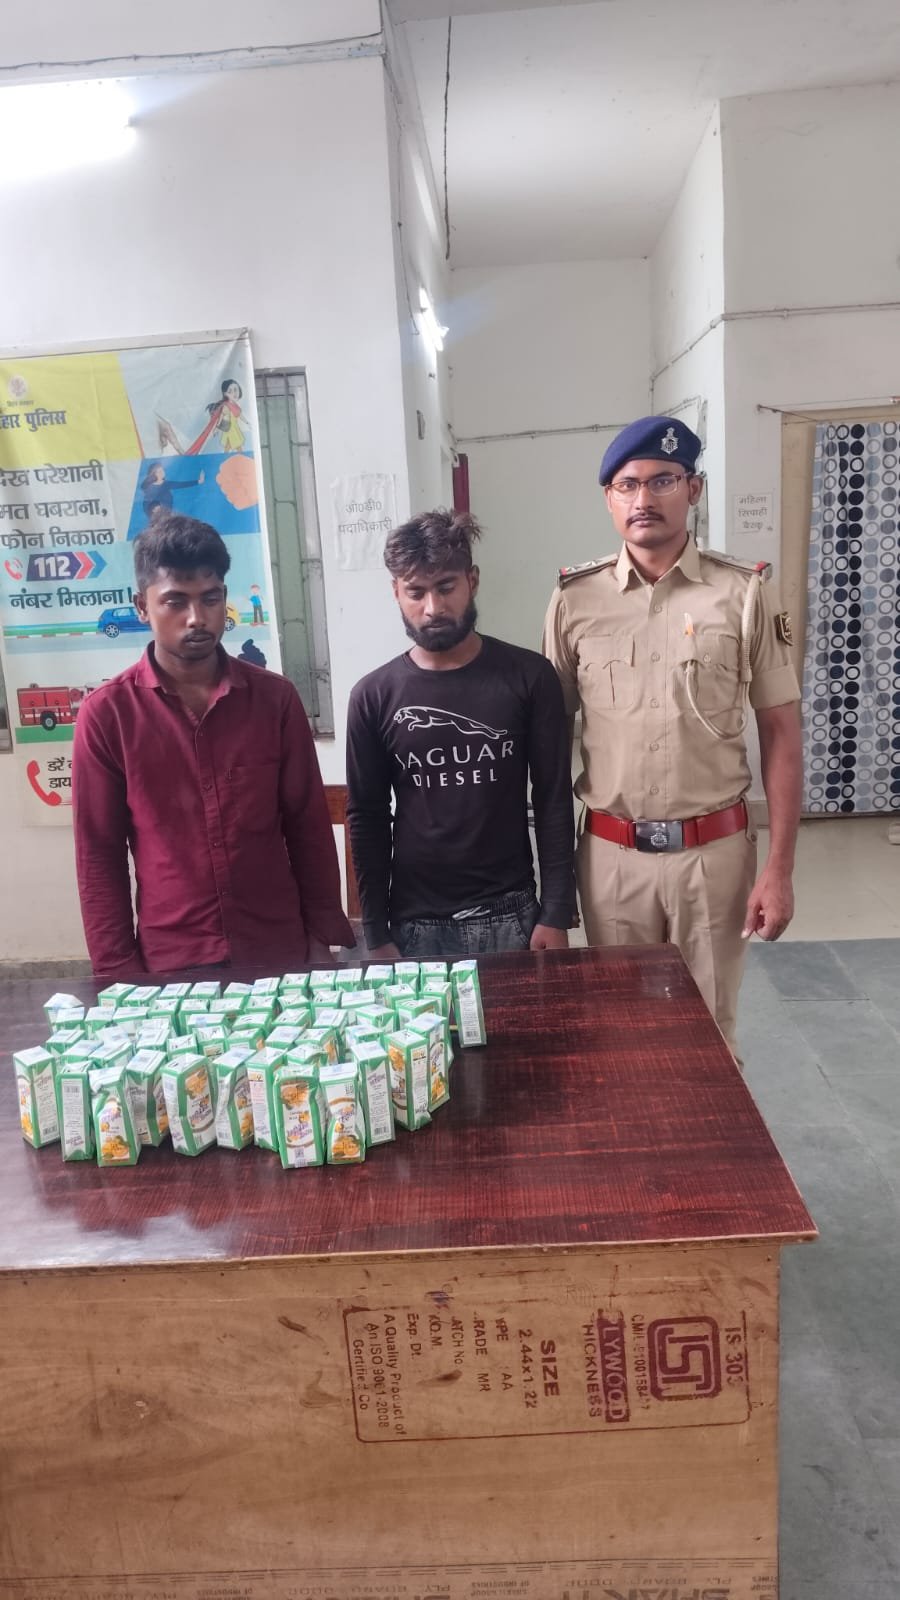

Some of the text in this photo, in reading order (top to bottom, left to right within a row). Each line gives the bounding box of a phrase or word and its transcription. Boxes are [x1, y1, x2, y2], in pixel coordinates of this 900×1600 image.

[0, 408, 67, 432] हार पुलिस
[34, 459, 104, 484] परेशानी
[0, 499, 108, 520] मत घबराना,
[0, 526, 115, 550] फोन निकाल
[34, 555, 71, 578] 112
[9, 587, 54, 609] नंबर
[394, 740, 514, 770] JAGUAR
[48, 776, 72, 789] डाय
[411, 768, 498, 788] DIESEL
[384, 1313, 396, 1324] A
[406, 1313, 420, 1340] Exp.
[366, 1322, 379, 1340] An
[451, 1316, 465, 1348] ATCH
[473, 1313, 488, 1356] RADE
[370, 1343, 384, 1366] ISO
[385, 1326, 400, 1370] Quality
[540, 1339, 560, 1397] SIZE
[395, 1423, 407, 1435] of
